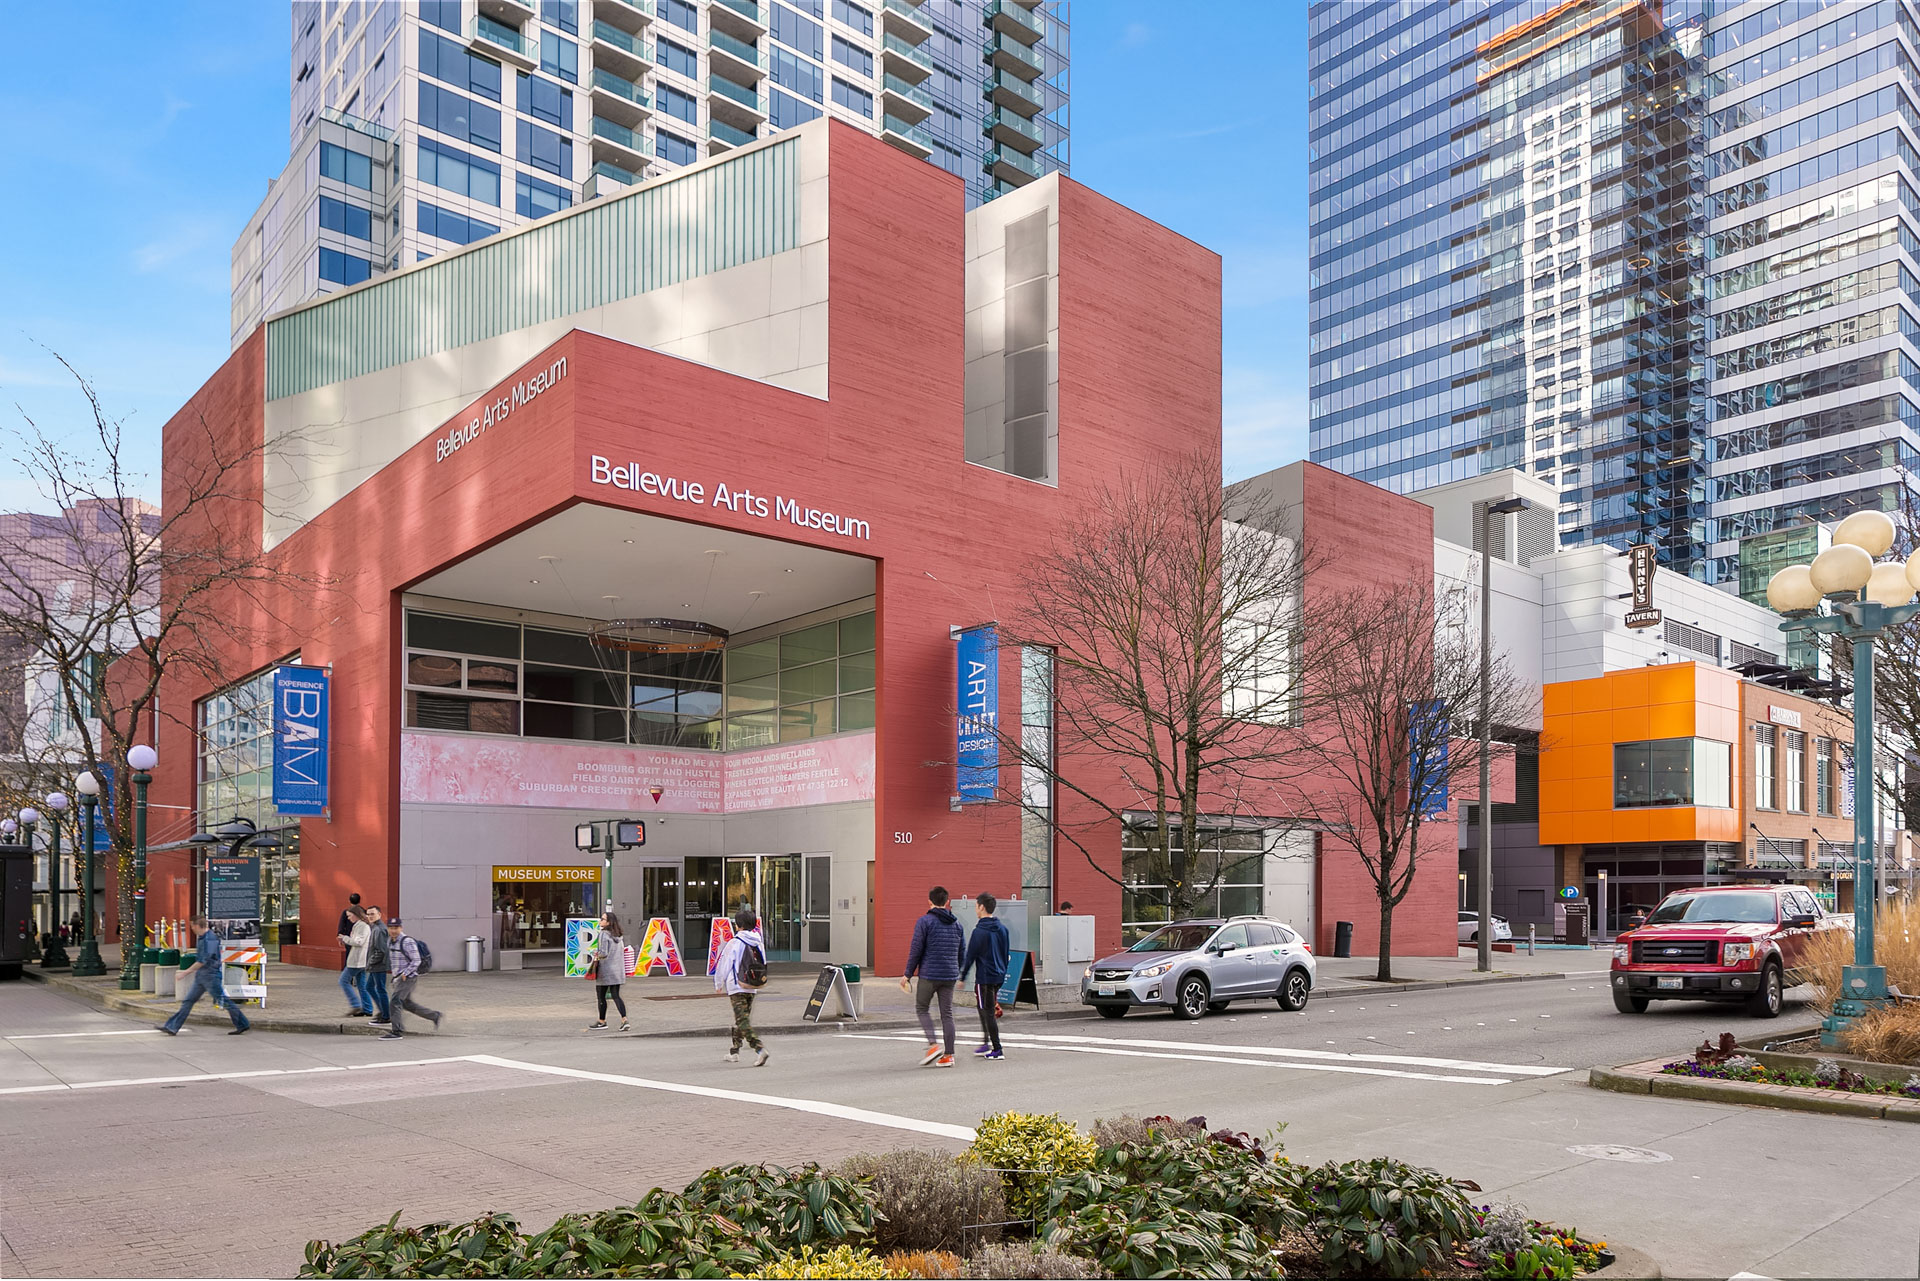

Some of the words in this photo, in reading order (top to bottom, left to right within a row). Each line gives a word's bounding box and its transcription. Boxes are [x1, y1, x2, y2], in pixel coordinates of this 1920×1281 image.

[436, 418, 480, 462] Bellevue
[482, 397, 510, 432] Arts
[512, 356, 567, 412] Museum
[591, 455, 704, 504] Bellevue
[712, 483, 768, 517] Arts
[775, 496, 870, 540] Museum
[1636, 550, 1646, 602] HENRY'S
[1626, 611, 1658, 623] TAVERN
[279, 680, 324, 690] EXPERIENCE
[968, 660, 987, 712] ART
[958, 712, 996, 736] CRAFT
[283, 688, 320, 785] BAM
[648, 756, 668, 764] YOU
[671, 758, 691, 766] HAD
[693, 758, 706, 766] ME
[708, 760, 720, 768] AT
[724, 759, 741, 768] YOUR
[742, 752, 780, 766] WOODLANDS
[781, 748, 816, 760] WETLANDS
[578, 762, 634, 774] BOOMBURG
[638, 766, 660, 774] GRIT
[663, 768, 682, 776] AND
[685, 769, 720, 778] HUSTLE
[724, 768, 753, 778] TRESTLES
[755, 766, 767, 774] AND
[768, 761, 798, 773] TUNNELS
[799, 758, 821, 770] BERRY
[572, 774, 608, 783] FIELDS
[610, 776, 640, 785] DAIRY
[643, 778, 675, 787] FARMS
[678, 779, 720, 789] LOGGERS
[724, 778, 747, 789] MINERS
[748, 776, 774, 787] BIOTECH
[776, 772, 810, 782] DREAMERS
[811, 768, 839, 778] FERTILE
[519, 782, 577, 792] SUBURBAN
[581, 786, 633, 796] CRESCENT
[666, 790, 720, 799] EVERGREEN
[724, 790, 751, 800] EXPANSE
[752, 787, 769, 797] YOUR
[770, 784, 795, 795] BEAUTY
[797, 783, 805, 792] AT
[696, 801, 720, 810] THAT
[725, 798, 756, 810] BEAUTIFUL
[758, 798, 774, 807] VIEW
[636, 824, 644, 842] 3
[894, 832, 912, 844] 510
[498, 870, 552, 880] MUSEUM
[556, 870, 595, 880] STORE
[1567, 889, 1574, 897] P
